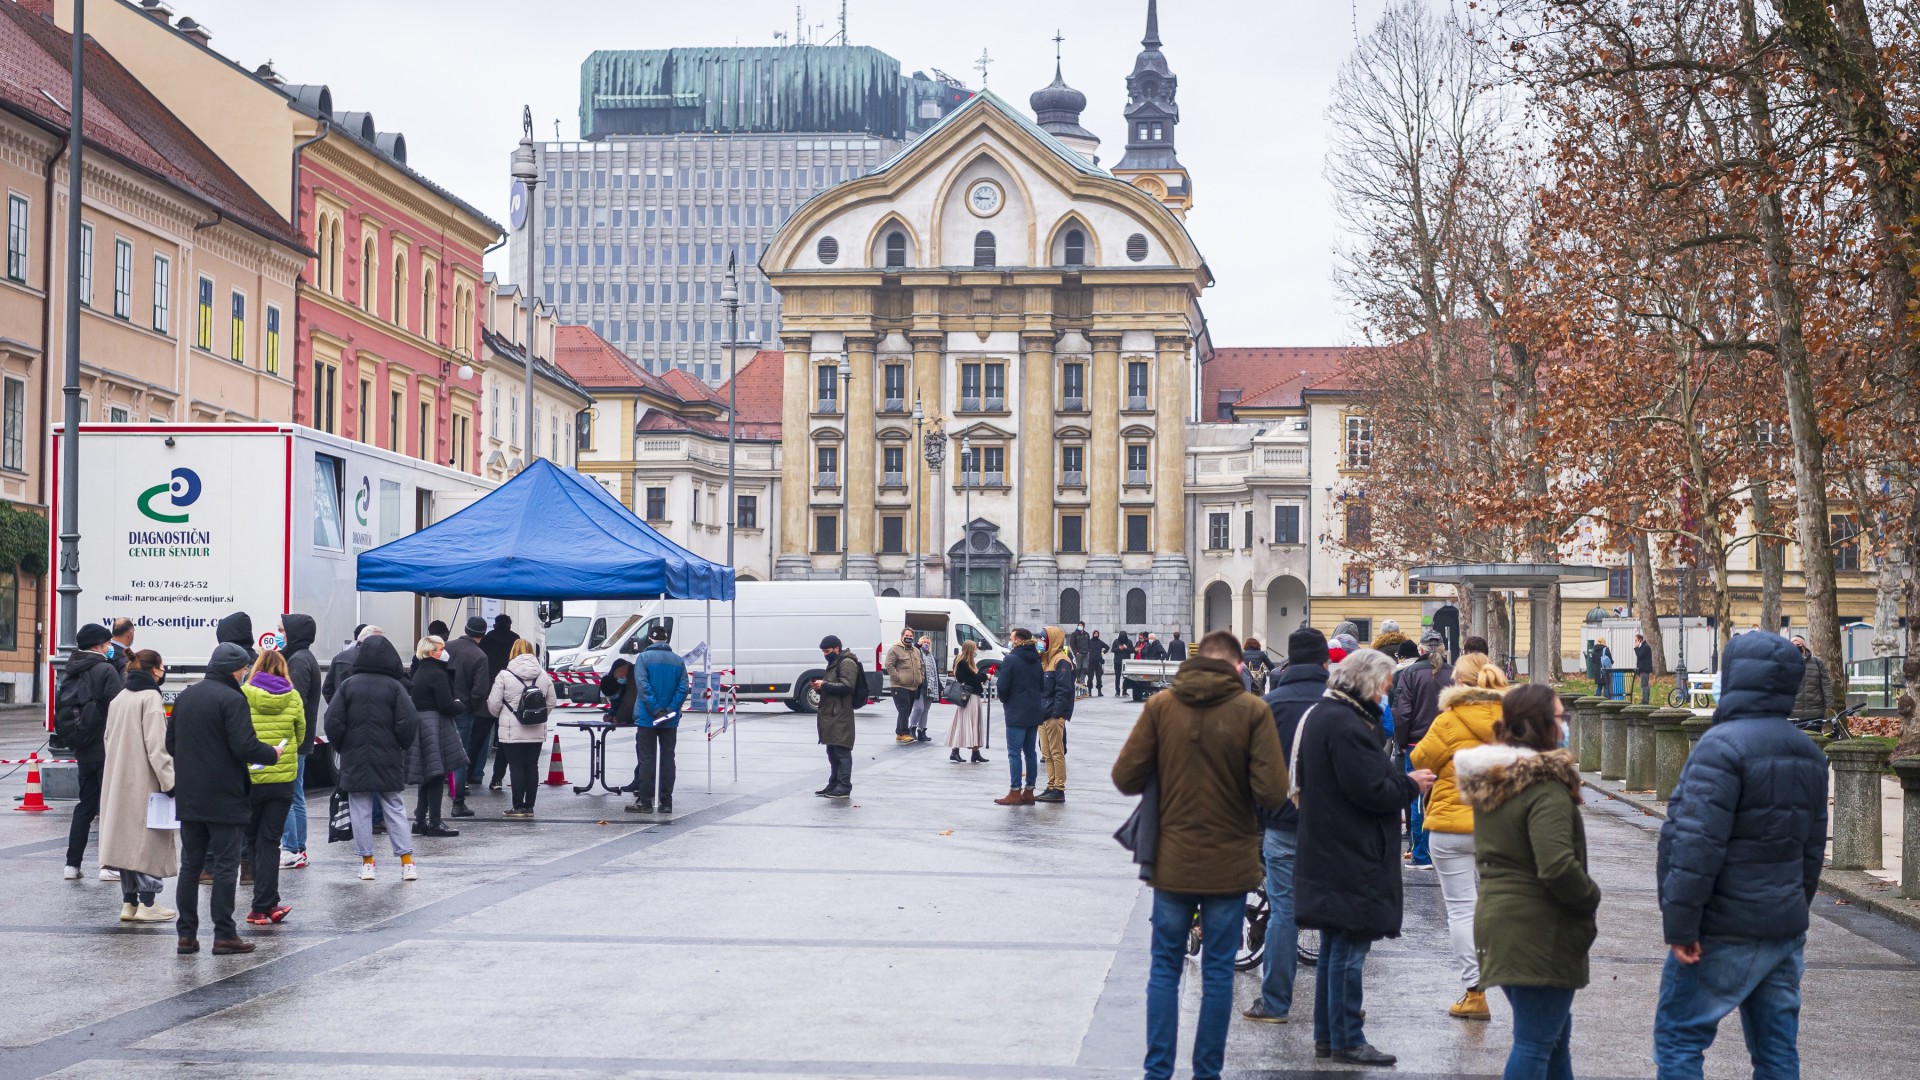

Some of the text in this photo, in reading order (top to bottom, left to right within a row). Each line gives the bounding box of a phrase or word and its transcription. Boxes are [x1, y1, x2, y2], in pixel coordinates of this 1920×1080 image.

[129, 528, 210, 545] DIAGNOSTIČNI
[129, 545, 210, 557] CENTER ŠENTJUR
[131, 580, 209, 589] Tel: 03/746-25-52
[105, 594, 234, 604] e-mail: narocanje@dc-sentjur.si
[102, 615, 218, 629] w.dc-sentjur.c
[264, 637, 274, 645] 60
[161, 692, 180, 701] VS-3
